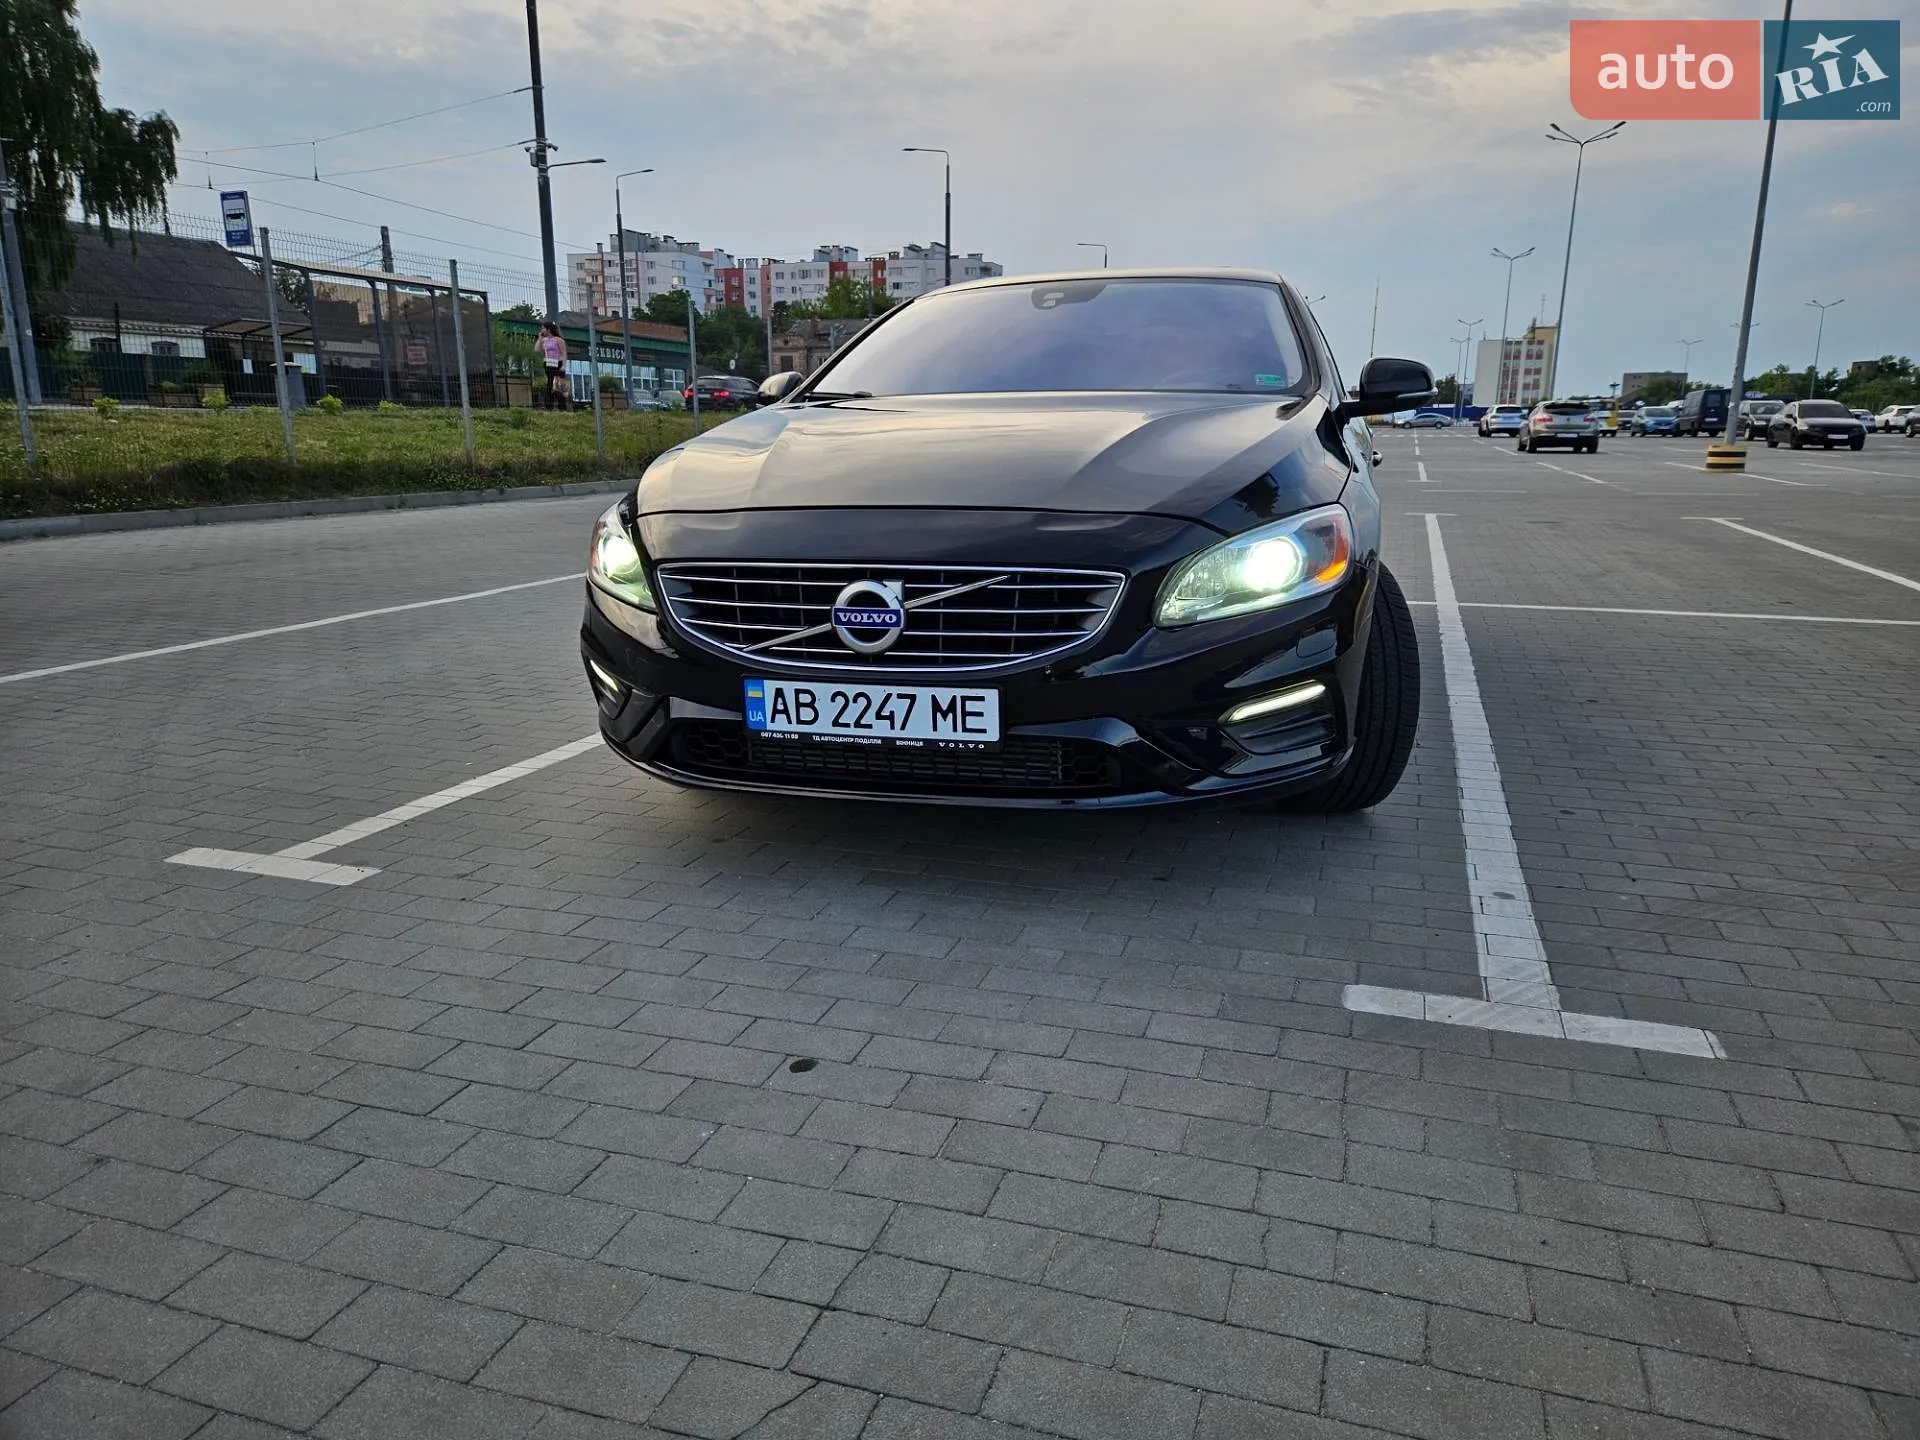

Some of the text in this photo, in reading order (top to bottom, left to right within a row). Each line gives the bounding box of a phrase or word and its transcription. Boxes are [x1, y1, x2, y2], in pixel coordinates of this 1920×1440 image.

[837, 612, 897, 623] VOLVO
[749, 710, 765, 722] UA
[770, 687, 988, 734] AB 2247 ME
